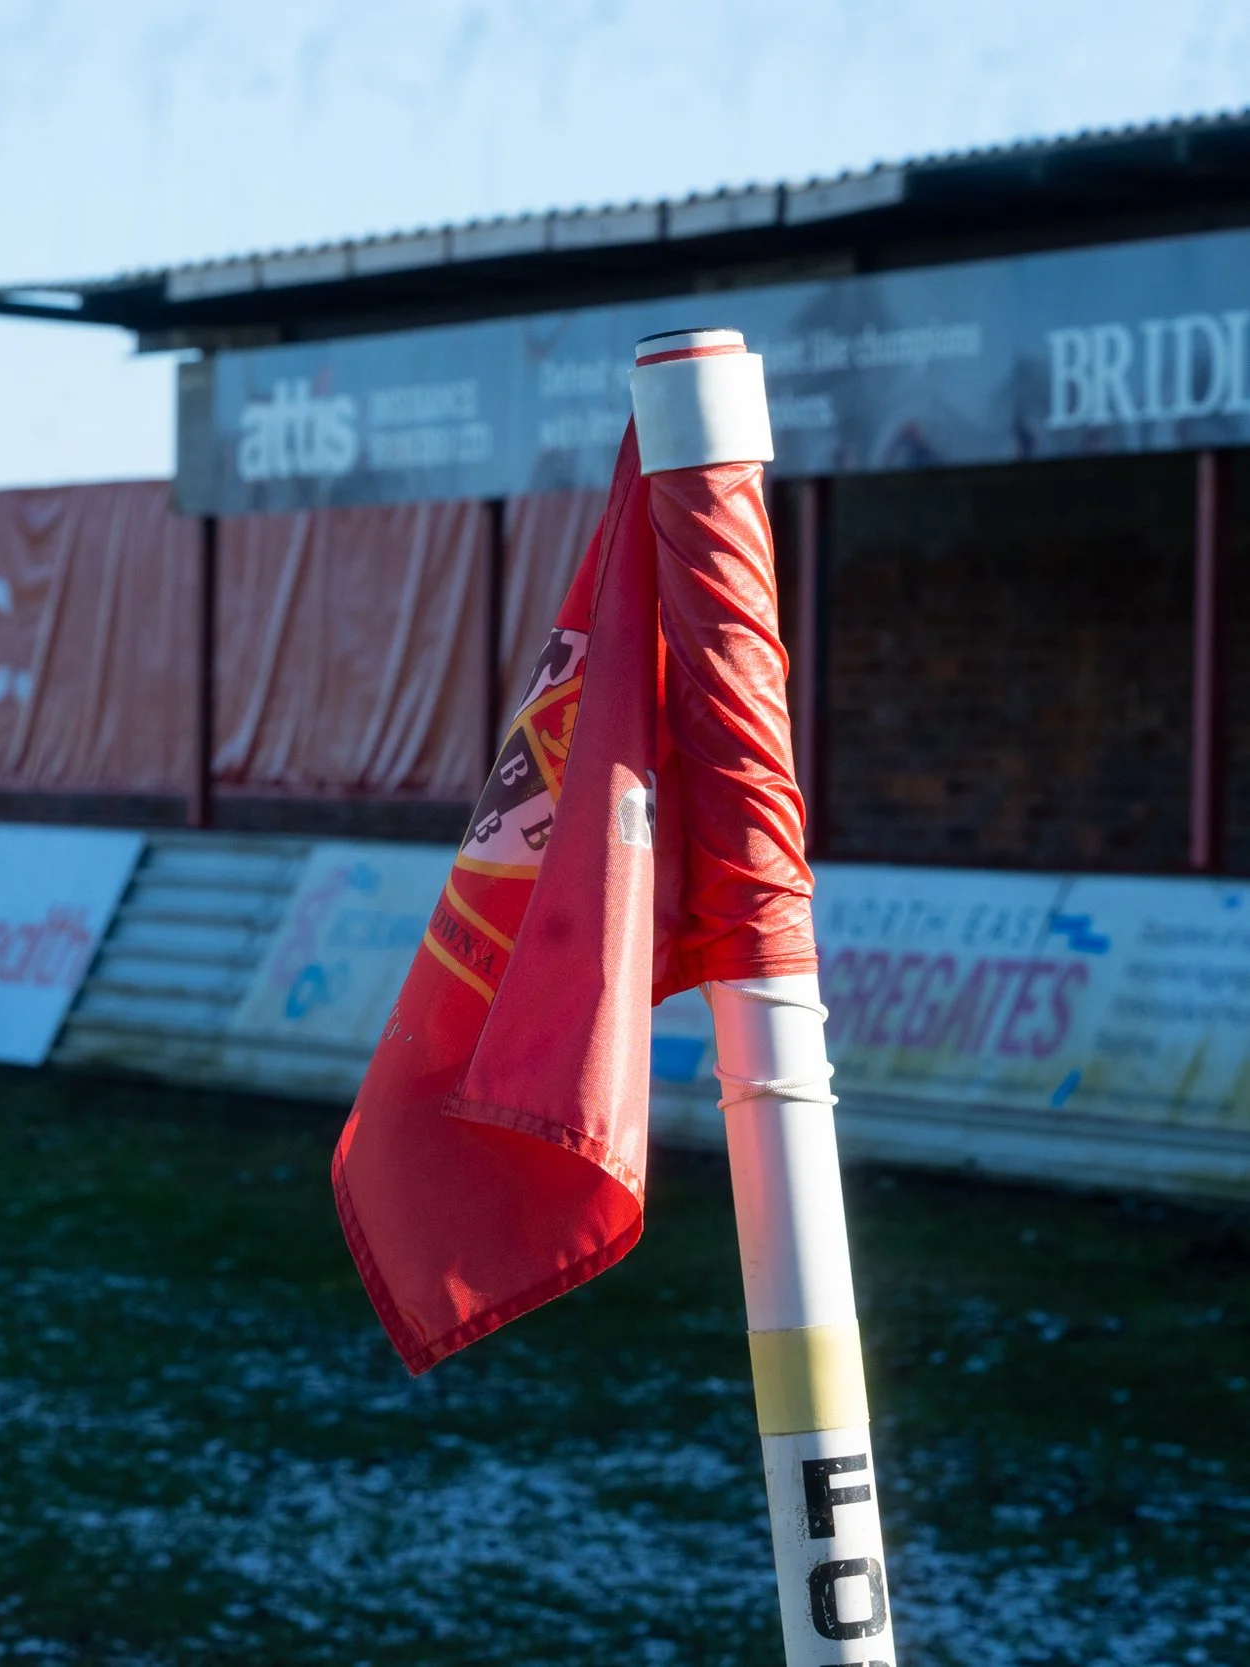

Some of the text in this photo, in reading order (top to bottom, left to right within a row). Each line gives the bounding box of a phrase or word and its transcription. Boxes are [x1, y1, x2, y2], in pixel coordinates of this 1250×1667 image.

[500, 751, 529, 787] B
[474, 808, 503, 844] B
[520, 812, 554, 851] B
[430, 902, 479, 957] OWN
[818, 942, 1092, 1061] GREGATES
[800, 1453, 893, 1667] FO
